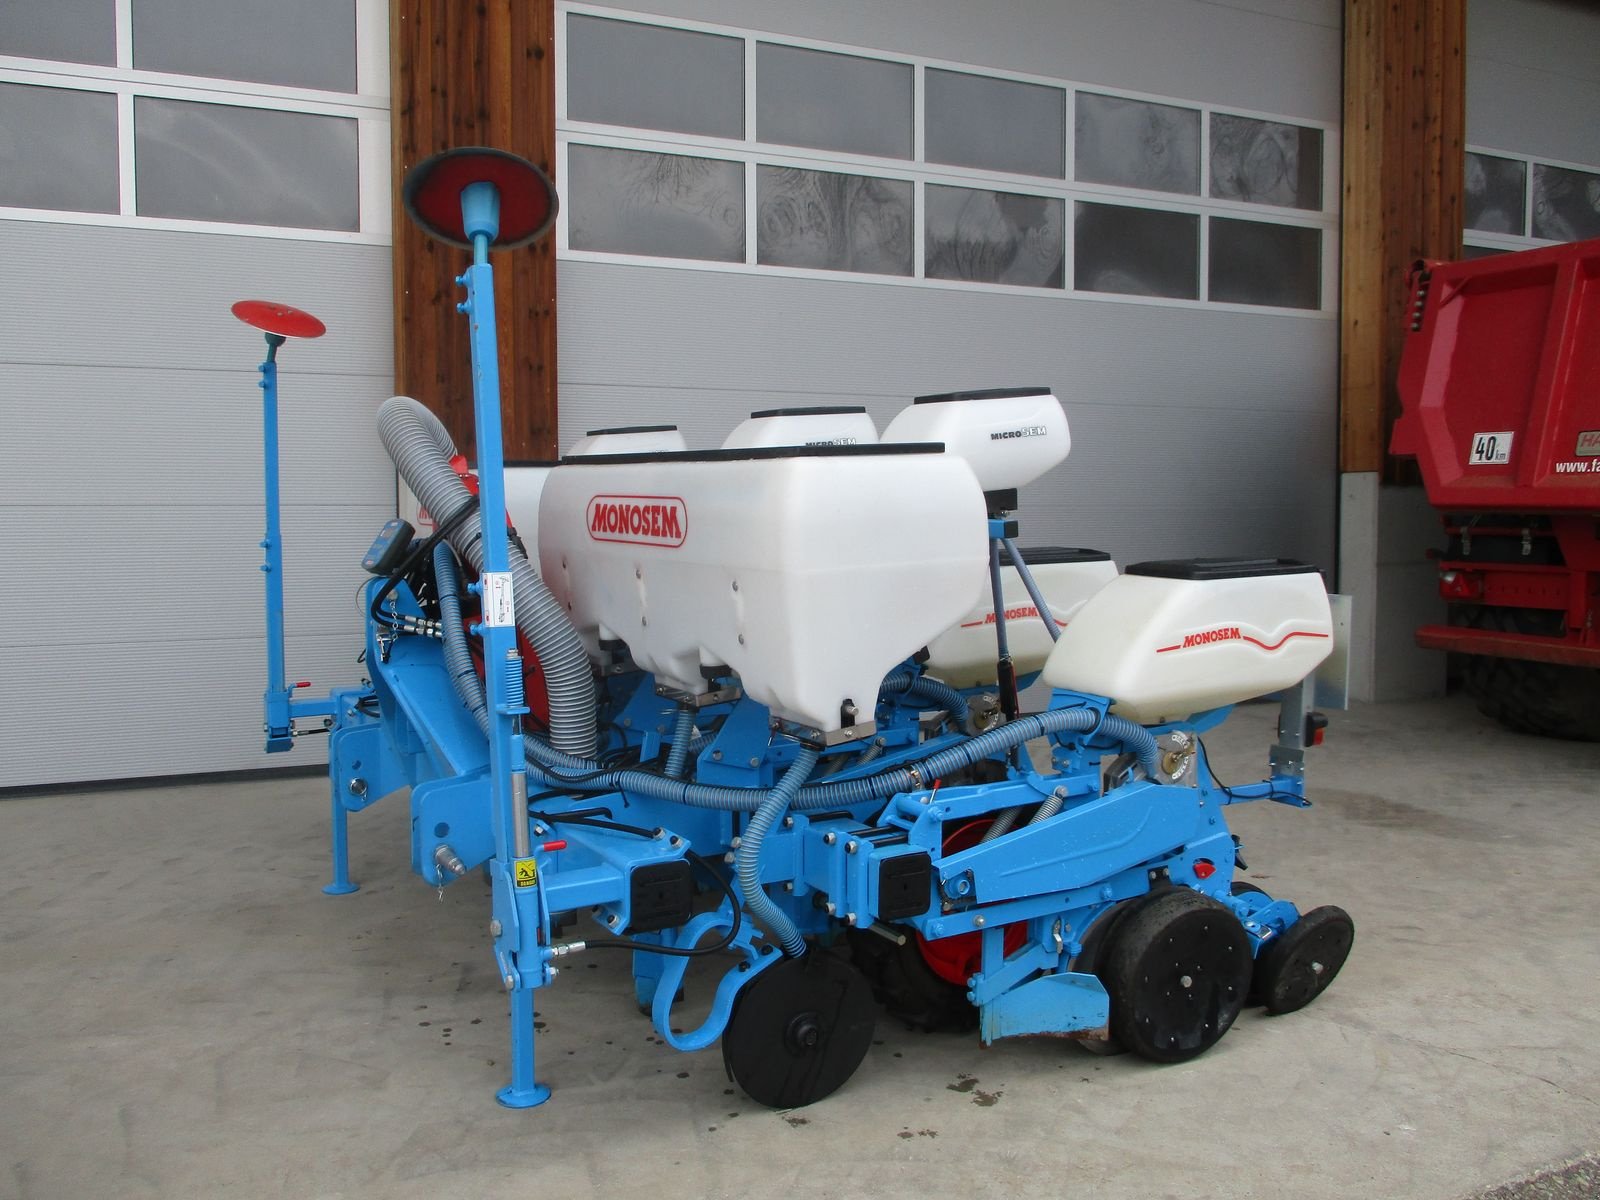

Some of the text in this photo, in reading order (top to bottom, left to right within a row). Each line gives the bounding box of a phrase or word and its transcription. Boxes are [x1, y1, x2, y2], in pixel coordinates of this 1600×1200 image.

[991, 426, 1047, 440] MICROSEM
[1475, 436, 1506, 461] 40 km
[591, 503, 682, 539] MONOSEM
[984, 607, 1038, 624] MNOSEM
[1183, 627, 1241, 648] MONOSEM
